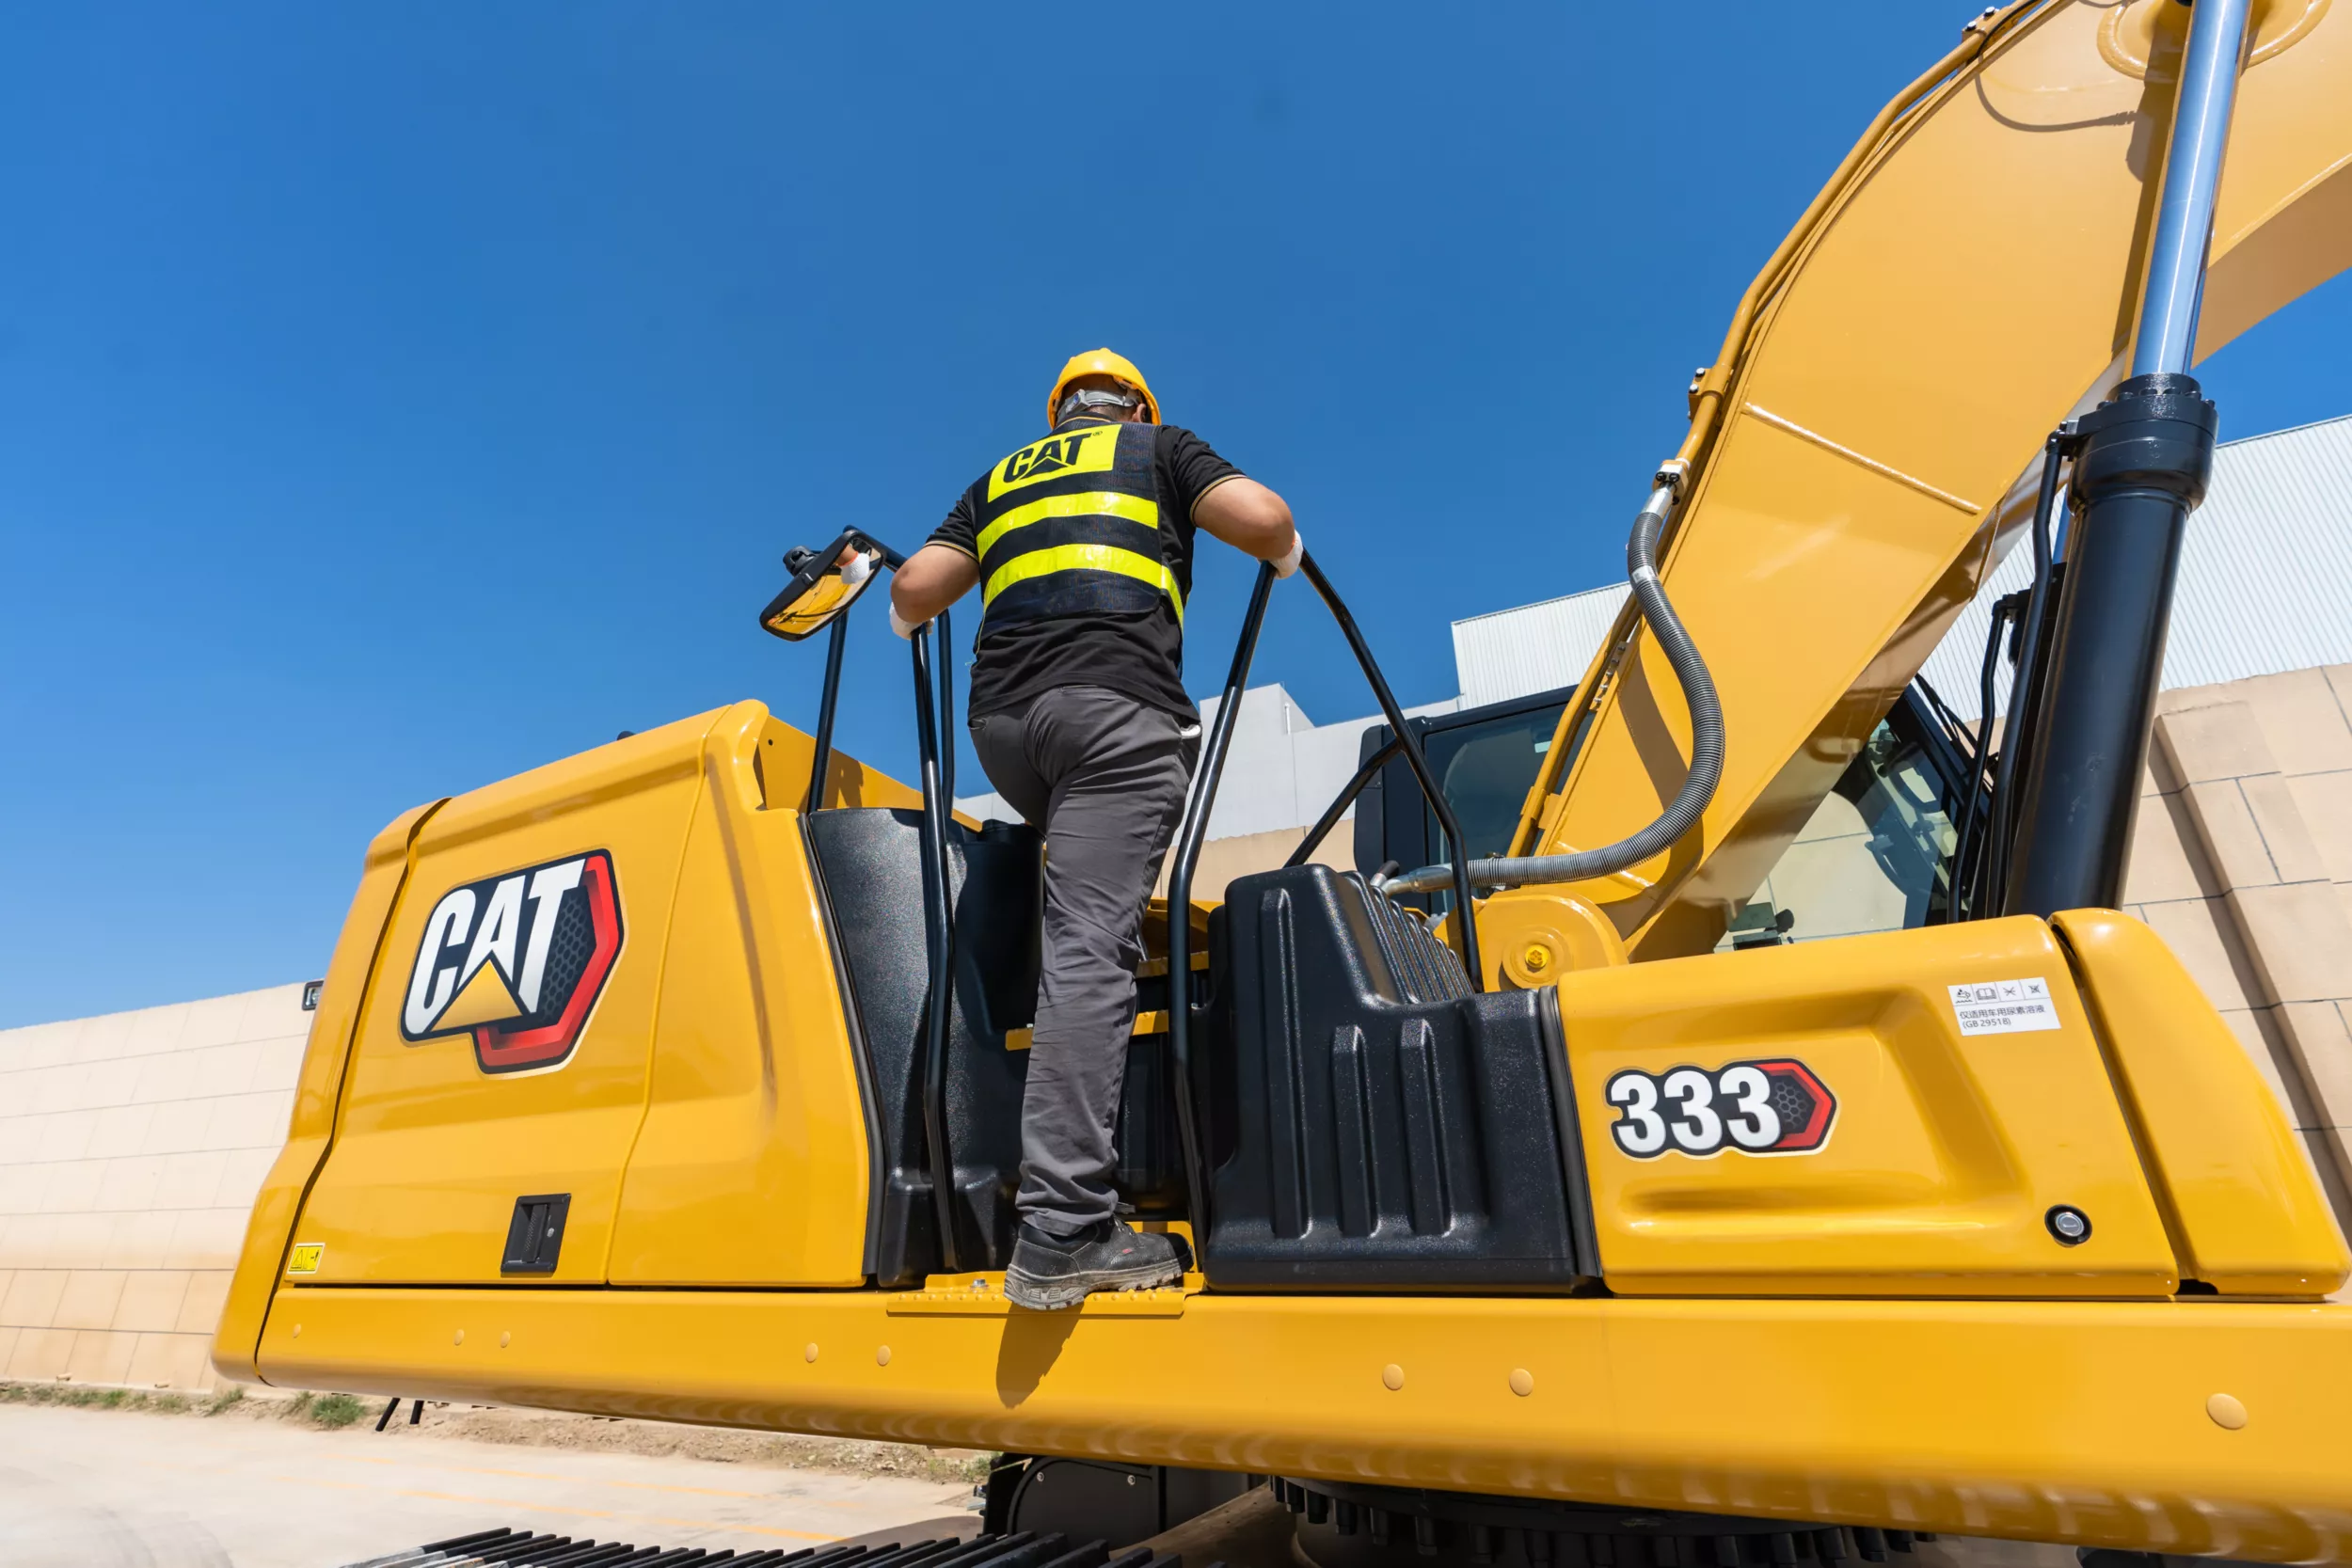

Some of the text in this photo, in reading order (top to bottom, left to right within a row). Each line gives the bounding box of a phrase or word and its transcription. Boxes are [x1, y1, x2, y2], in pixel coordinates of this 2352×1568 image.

[1003, 433, 1092, 483] CAT
[405, 859, 586, 1034] CAT
[1963, 1018, 2011, 1029] (GB 29518)
[1611, 1066, 1781, 1152] 333
